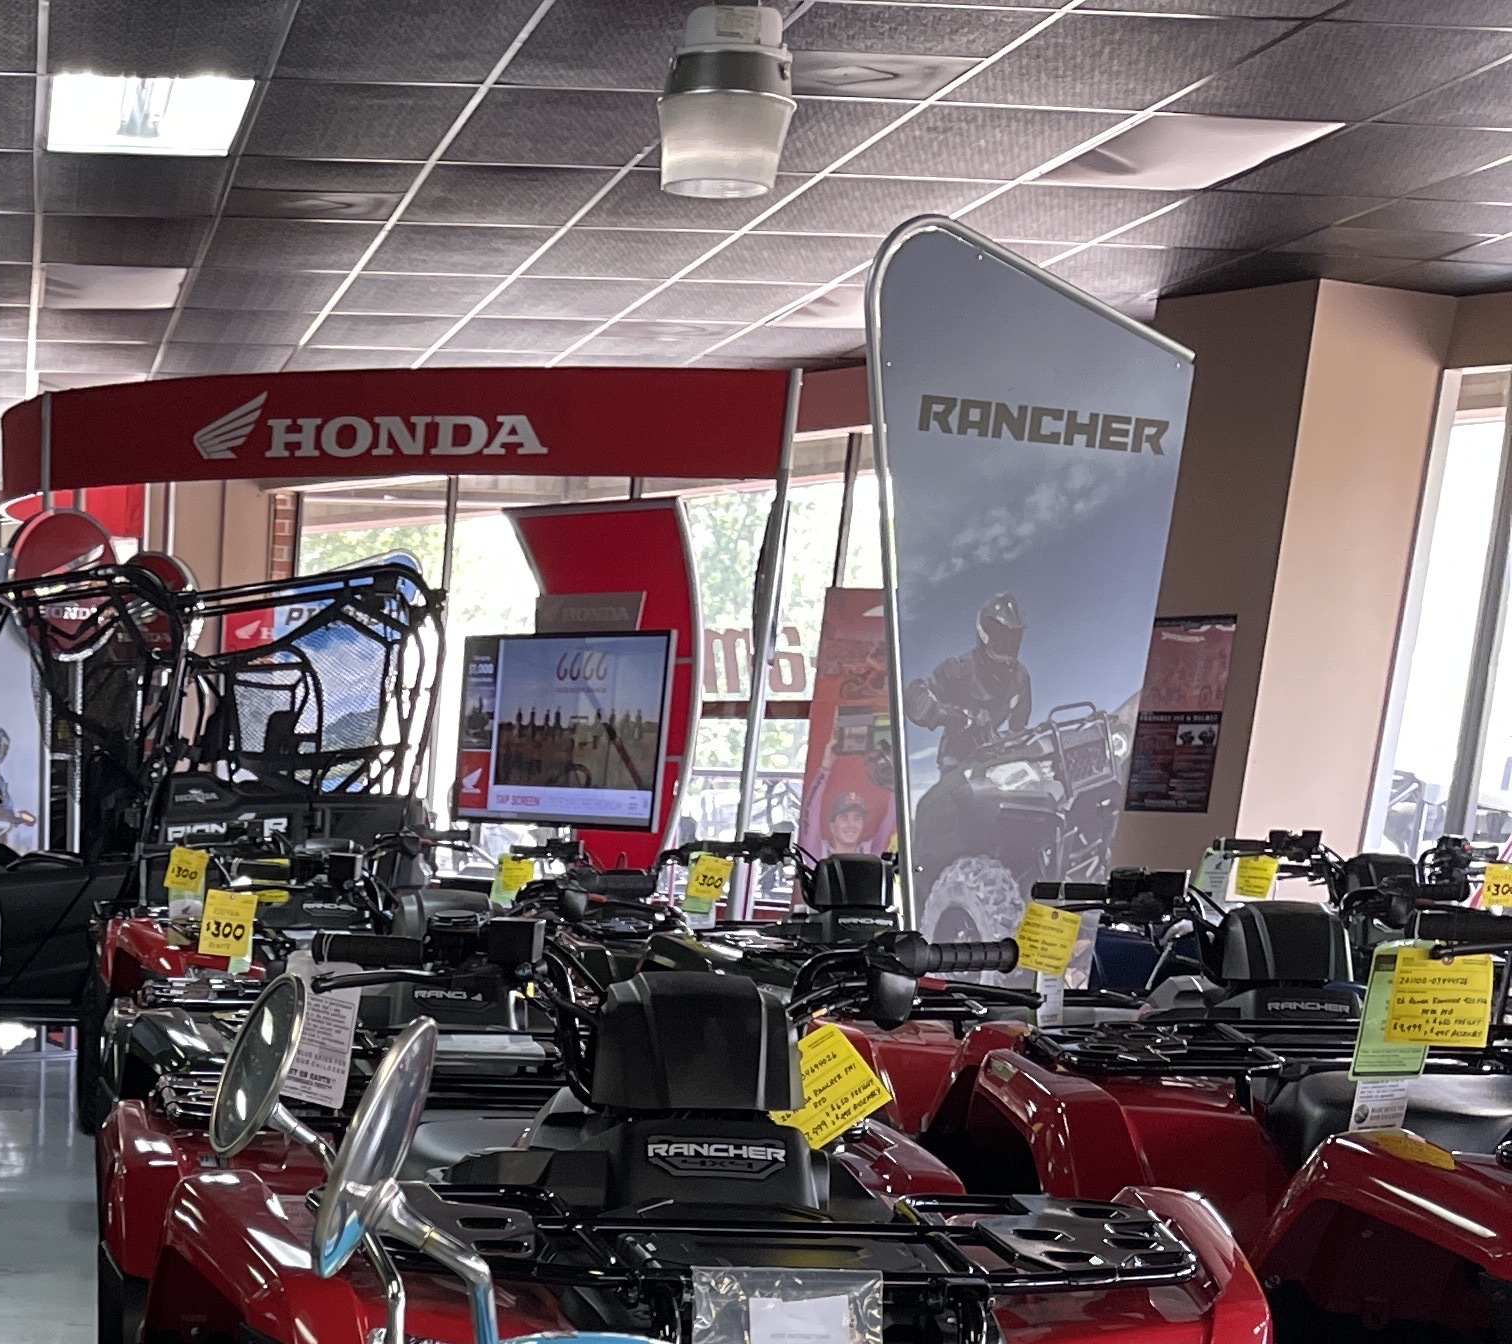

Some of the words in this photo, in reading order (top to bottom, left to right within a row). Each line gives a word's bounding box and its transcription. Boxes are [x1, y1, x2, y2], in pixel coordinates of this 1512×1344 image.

[918, 394, 1170, 456] RANCHER
[265, 415, 548, 457] HONDA
[171, 866, 198, 880] $300
[695, 873, 723, 889] $300
[206, 920, 245, 941] $300
[1267, 1001, 1350, 1014] RANCHER
[647, 1143, 786, 1162] RANCHER
